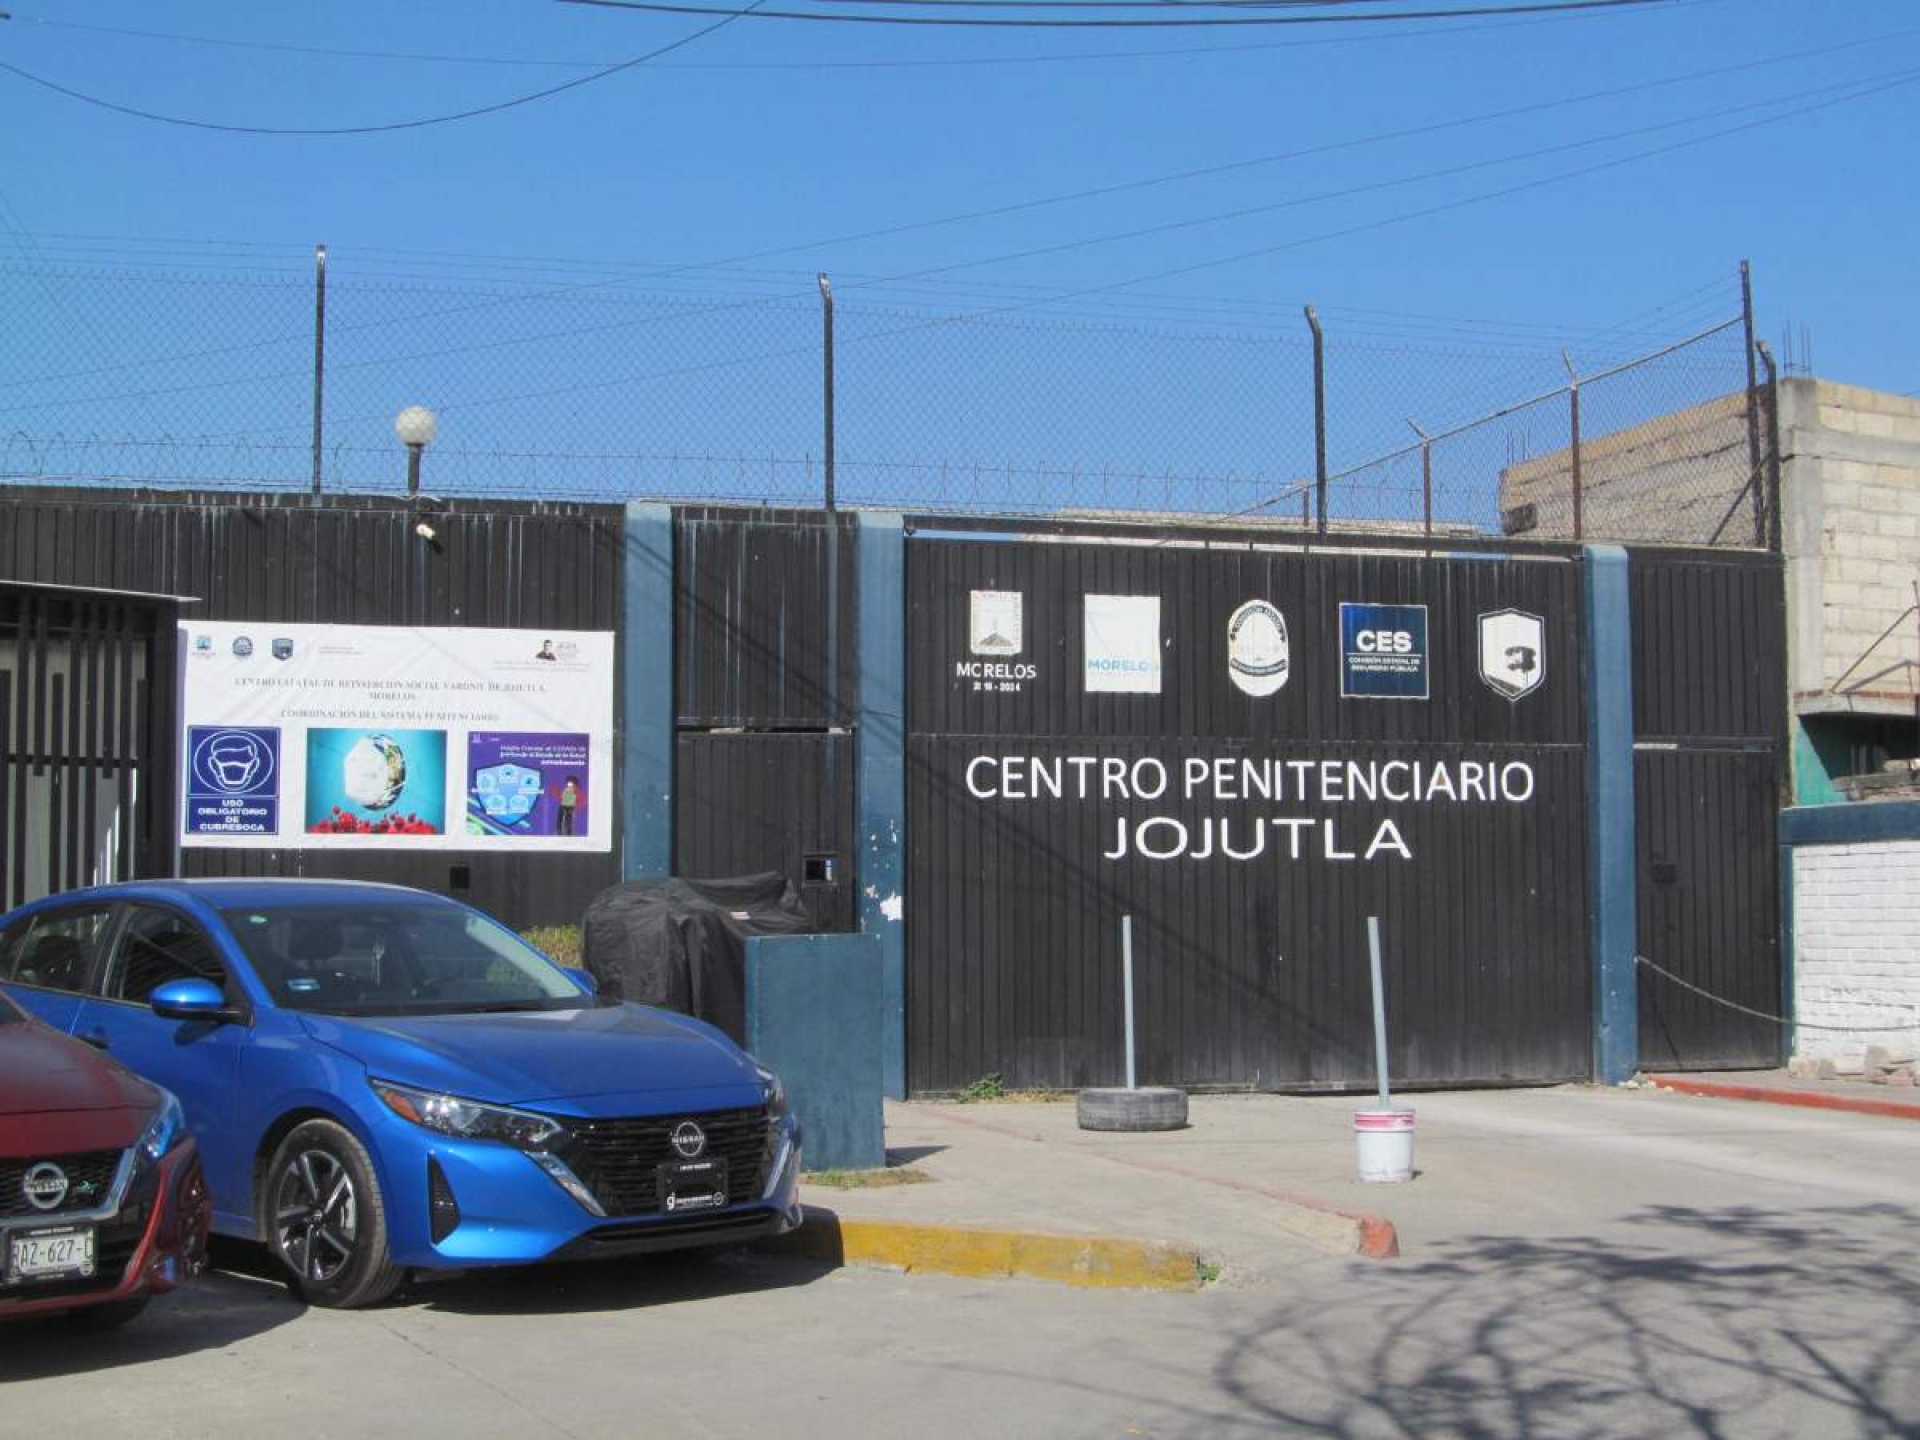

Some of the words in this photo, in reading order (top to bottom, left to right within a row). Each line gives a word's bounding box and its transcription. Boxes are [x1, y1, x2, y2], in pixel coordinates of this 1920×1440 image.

[1356, 630, 1412, 652] CES
[966, 755, 1167, 800] CENTRO
[1184, 757, 1534, 802] PENITENCIARIO
[222, 799, 244, 807] USO
[198, 807, 268, 816] OBLIGATORIO
[225, 815, 240, 823] DE
[1103, 816, 1412, 860] JOJUTLA
